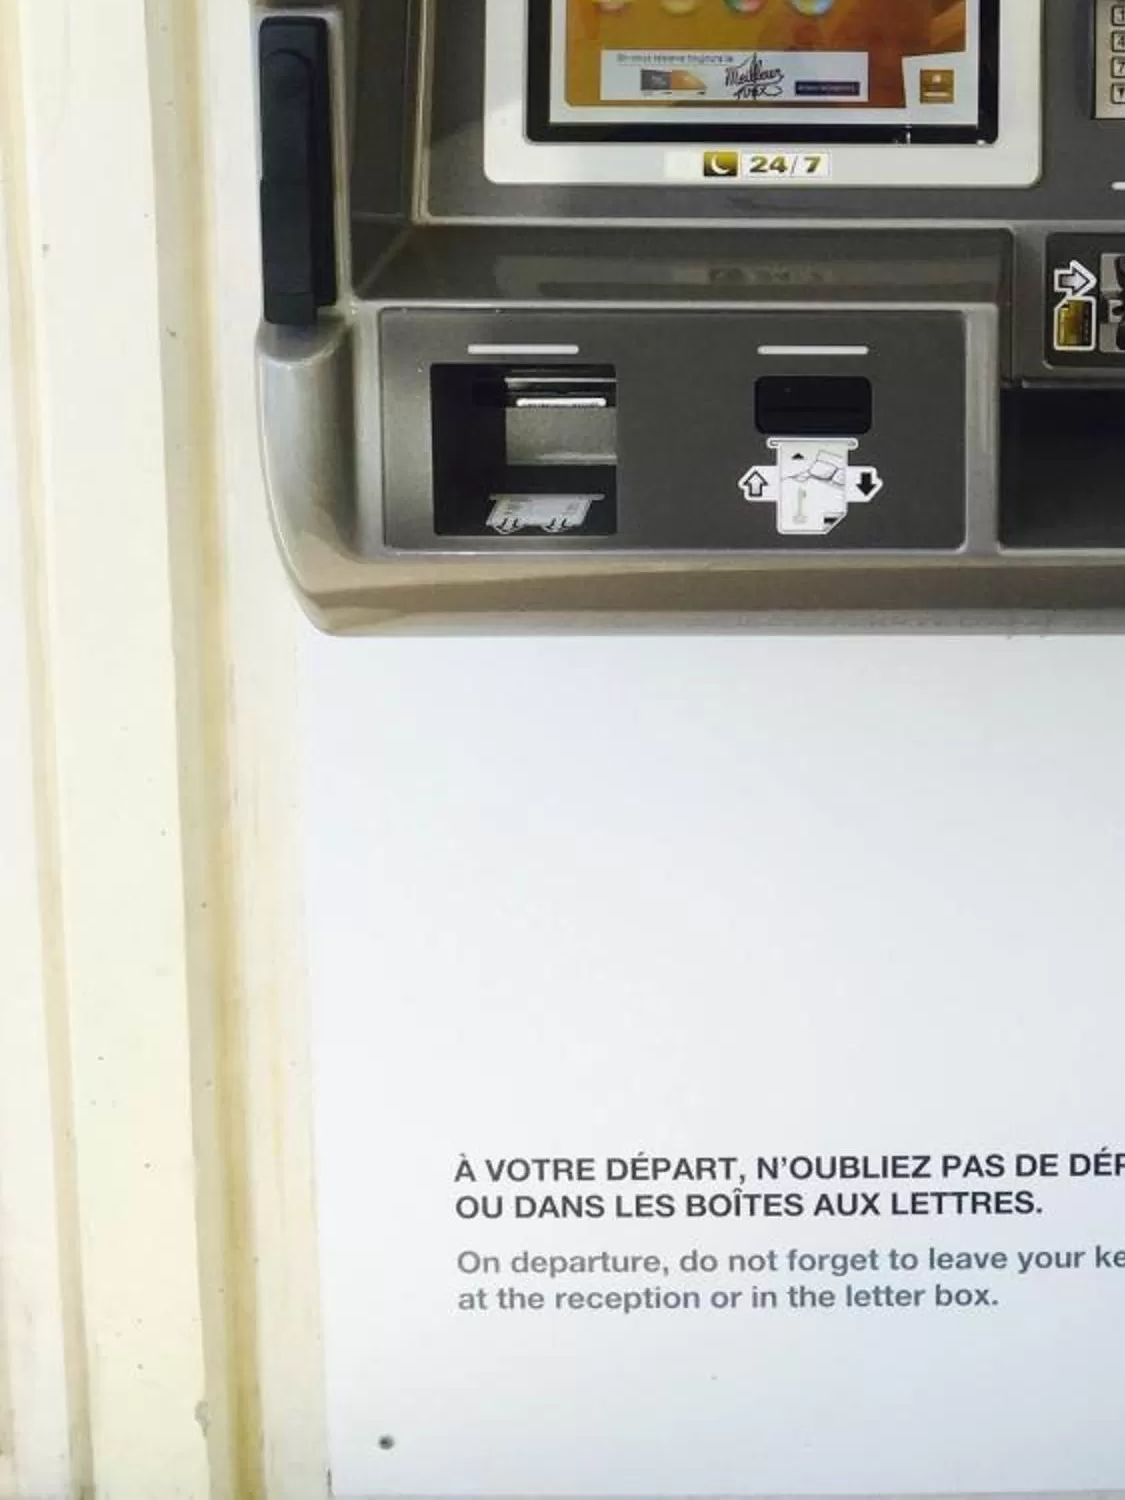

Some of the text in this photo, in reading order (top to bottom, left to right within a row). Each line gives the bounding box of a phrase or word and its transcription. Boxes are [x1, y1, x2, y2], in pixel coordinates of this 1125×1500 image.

[749, 155, 821, 174] 24/7
[454, 1153, 477, 1183] À
[484, 1157, 596, 1183] VOTRE
[606, 1151, 746, 1186] DÉPART,
[941, 1153, 1006, 1179] PAS
[1015, 1153, 1059, 1178] DE
[455, 1187, 1043, 1220] OU DANS LES BOÎTES AUX LETTRES.
[457, 1250, 501, 1275] On
[510, 1250, 669, 1279] departure,
[679, 1248, 719, 1274] do
[728, 1249, 779, 1273] not
[785, 1248, 880, 1278] forget
[887, 1248, 919, 1272] to
[928, 1246, 1009, 1271] leave
[1017, 1251, 1087, 1275] your
[457, 1283, 999, 1315] at the reception or in the letter box.
